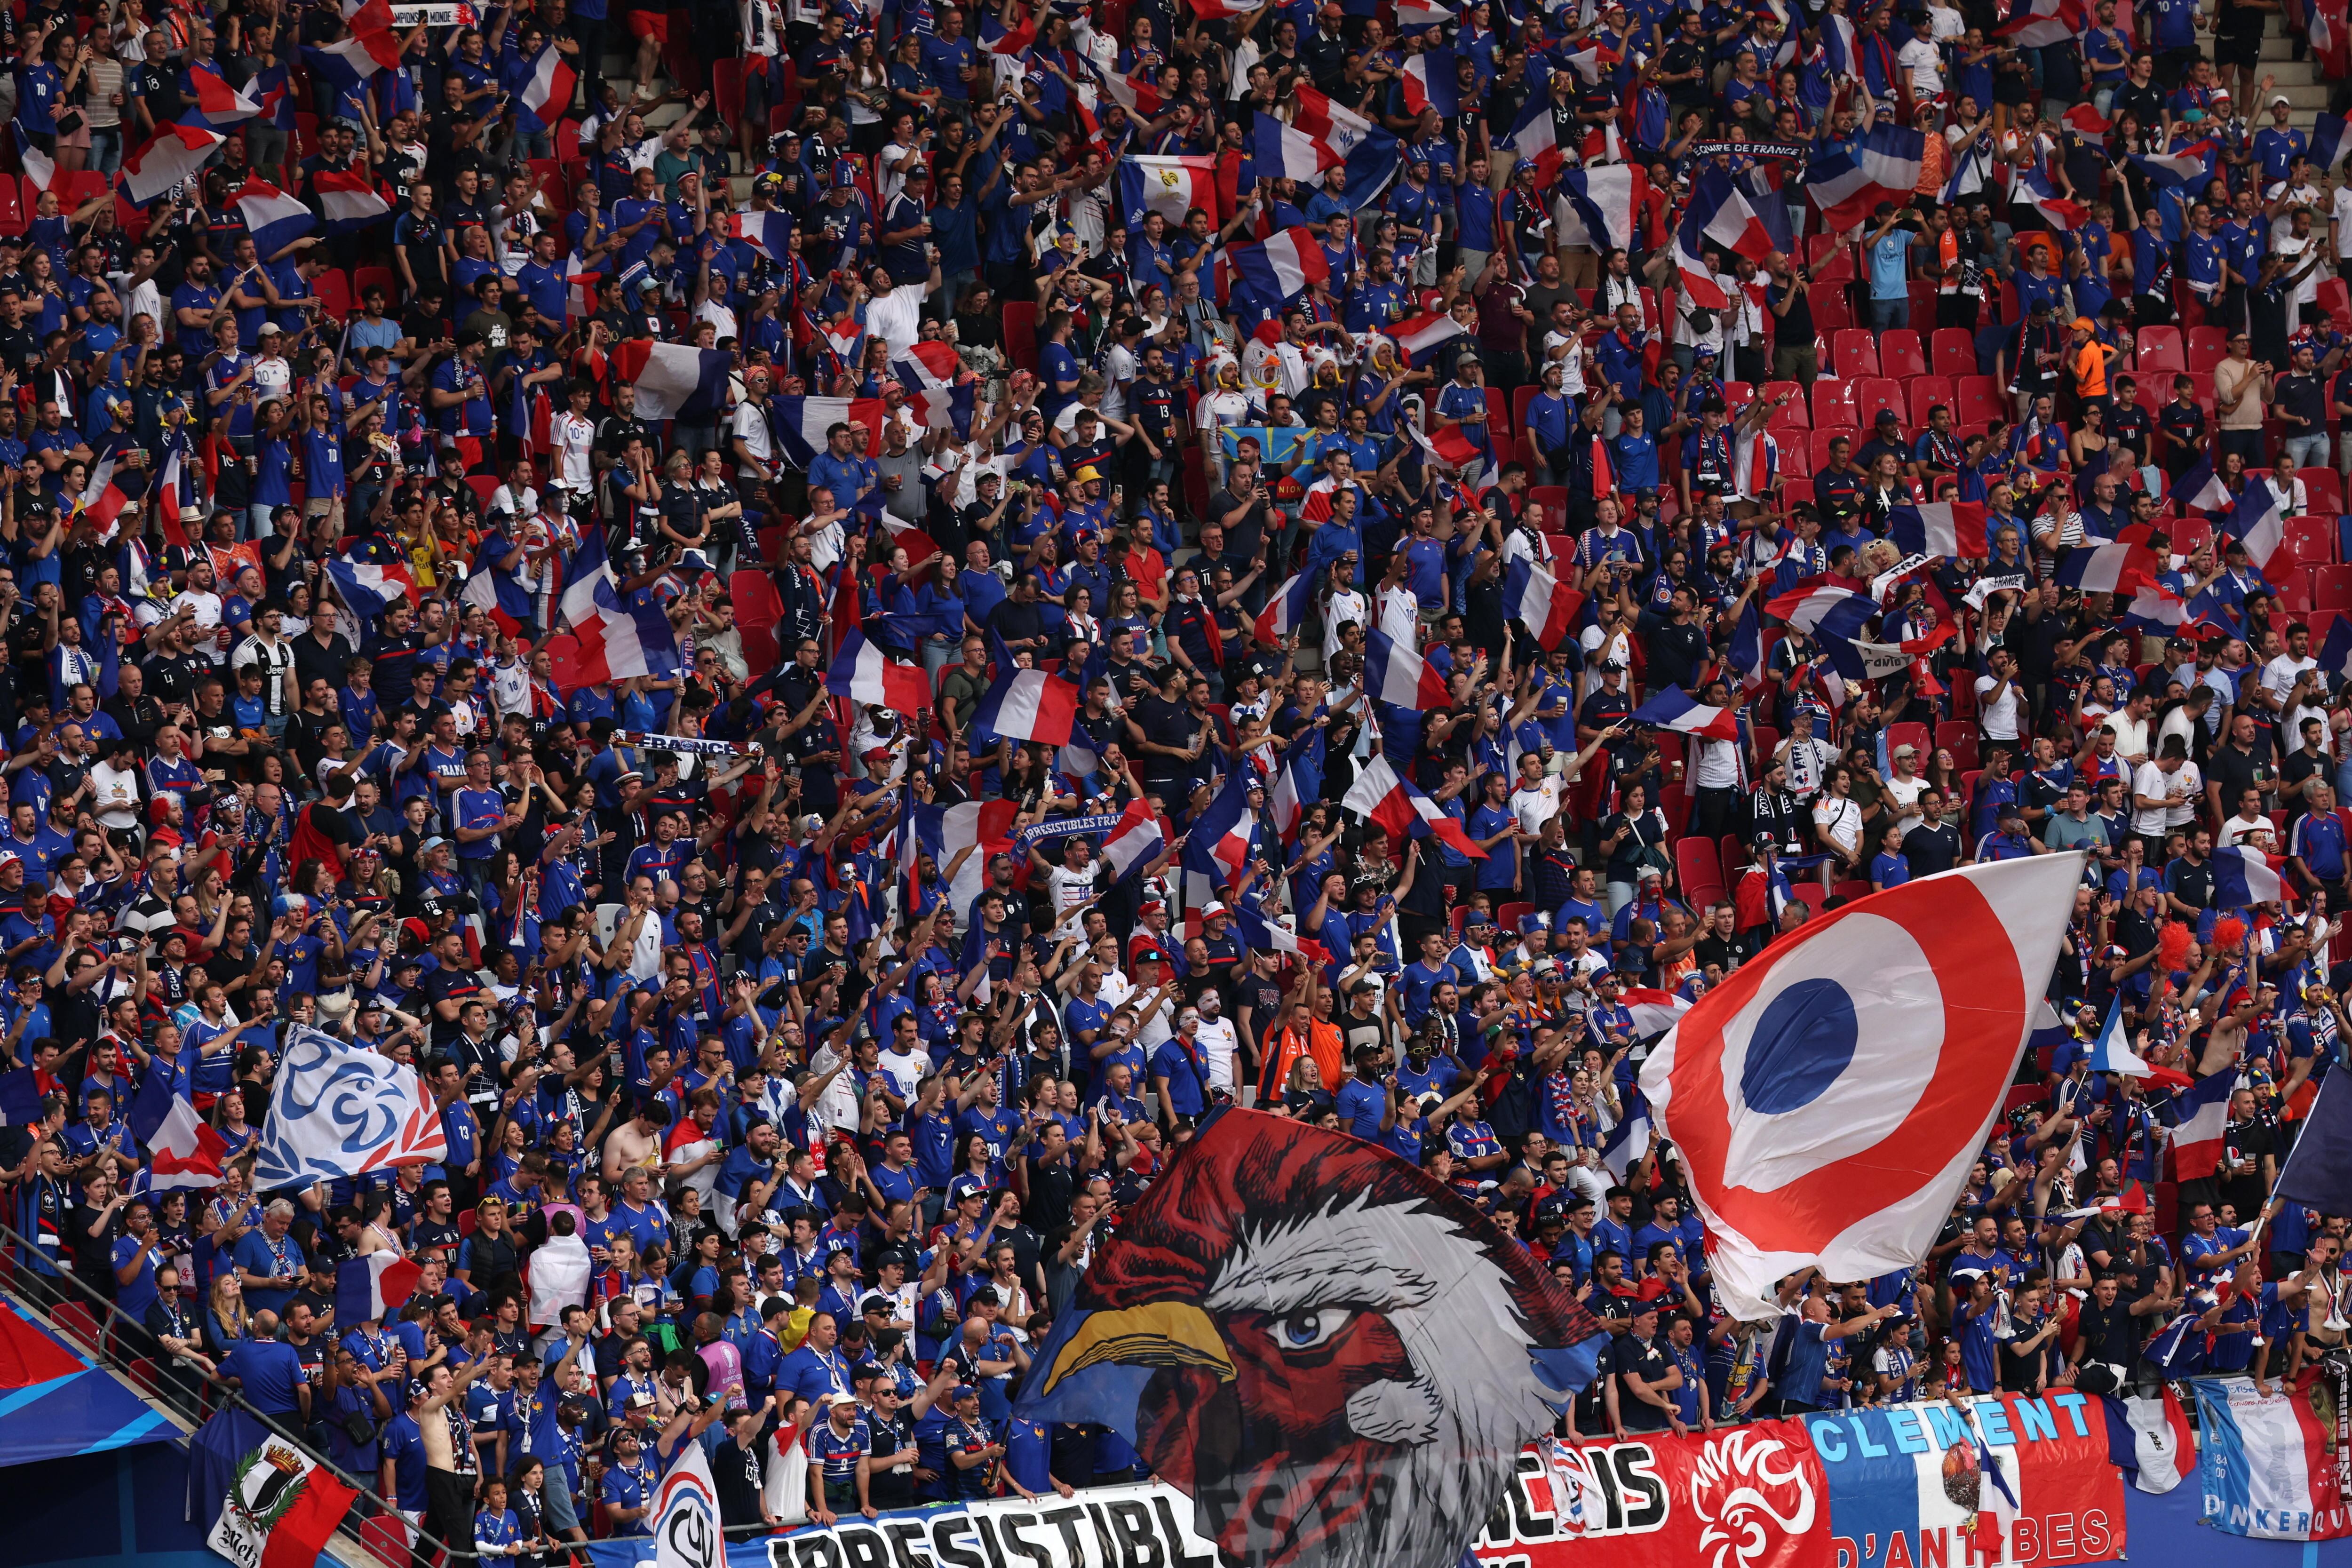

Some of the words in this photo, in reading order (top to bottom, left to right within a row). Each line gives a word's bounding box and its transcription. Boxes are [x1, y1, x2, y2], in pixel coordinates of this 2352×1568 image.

[2158, 1, 2169, 12] 10
[396, 14, 420, 25] MPIONS
[429, 11, 453, 23] MONDE
[1308, 14, 1312, 26] 7
[397, 67, 406, 78] 10
[36, 83, 46, 96] 10
[147, 78, 160, 91] 18
[1466, 112, 1472, 125] 9
[1017, 123, 1027, 135] 10
[2074, 136, 2084, 147] 10
[1693, 144, 1731, 157] EQUIPE
[1753, 144, 1799, 155] FRANCE
[2280, 153, 2286, 166] 7
[1517, 211, 1523, 222] 7
[2246, 245, 2254, 259] 10
[2207, 257, 2212, 270] 7
[1300, 295, 1314, 325] FRANC
[1364, 302, 1370, 312] 10
[1381, 303, 1387, 316] 7
[608, 330, 620, 342] 10
[775, 340, 780, 354] 7
[1573, 356, 1578, 367] 7
[257, 370, 270, 383] 10
[1160, 406, 1169, 418] 13
[570, 427, 580, 439] 10
[2126, 429, 2135, 439] 10
[2186, 428, 2192, 438] 10
[327, 448, 337, 462] 10
[375, 467, 382, 479] 9
[1278, 486, 1303, 494] NION
[1816, 547, 1828, 575] NCE
[1203, 573, 1210, 586] 11
[1994, 574, 2019, 588] FRANCE
[1406, 609, 1414, 622] 10
[683, 633, 694, 667] KRIJK
[1865, 653, 1913, 669] FONTOY
[265, 664, 286, 677] Jeep
[164, 674, 175, 686] 4
[508, 681, 518, 692] 18
[638, 736, 739, 755] FRANCE
[1793, 741, 1806, 767] ALLE
[37, 795, 46, 812] 10
[1024, 818, 1096, 842] IRRESISTIBLES
[1097, 814, 1124, 827] FRAN
[545, 831, 560, 844] NCE
[656, 869, 670, 881] 10
[569, 883, 574, 892] 7
[375, 901, 381, 909] 7
[1382, 927, 1388, 939] 9
[1656, 921, 1662, 933] 9
[649, 936, 654, 950] 7
[286, 970, 294, 985] 9
[1258, 988, 1280, 1009] FRANCE
[2313, 1033, 2325, 1045] 13
[2267, 1045, 2273, 1060] 9
[904, 1081, 913, 1094] 10
[458, 1125, 470, 1140] 13
[941, 1133, 947, 1147] 7
[1476, 1144, 1486, 1157] 10
[828, 1239, 841, 1251] 10
[447, 1249, 458, 1263] 10
[2018, 1272, 2025, 1282] 7
[1605, 1307, 1617, 1320] 10
[1810, 1393, 2090, 1462] CLEMENT
[2213, 1453, 2227, 1466] 84
[746, 1464, 754, 1481] 13
[2205, 1494, 2352, 1533] DNKERQU
[217, 1521, 258, 1568] Metz
[1831, 1509, 2111, 1568] D'ANTBES
